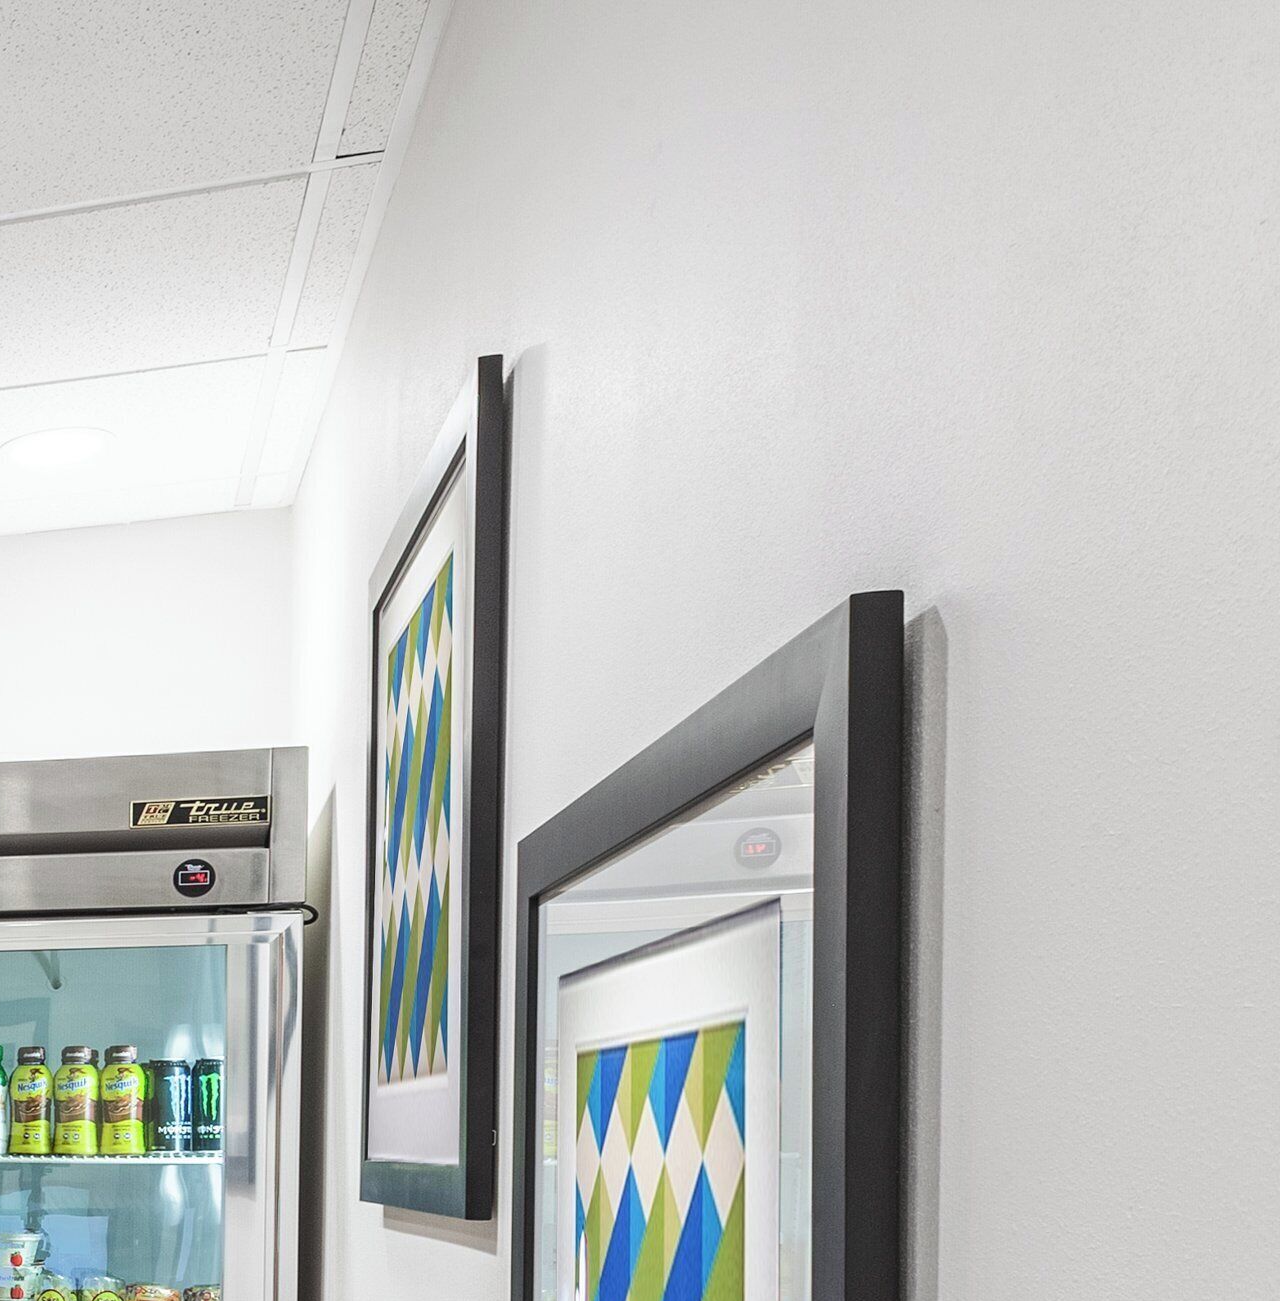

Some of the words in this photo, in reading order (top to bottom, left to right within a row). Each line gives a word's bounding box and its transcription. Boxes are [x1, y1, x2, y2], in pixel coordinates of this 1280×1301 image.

[179, 800, 260, 816] true
[189, 811, 260, 823] FREEZER
[17, 1080, 46, 1093] Nesquik
[57, 1079, 88, 1092] Nesquik
[105, 1079, 138, 1092] Nesquik
